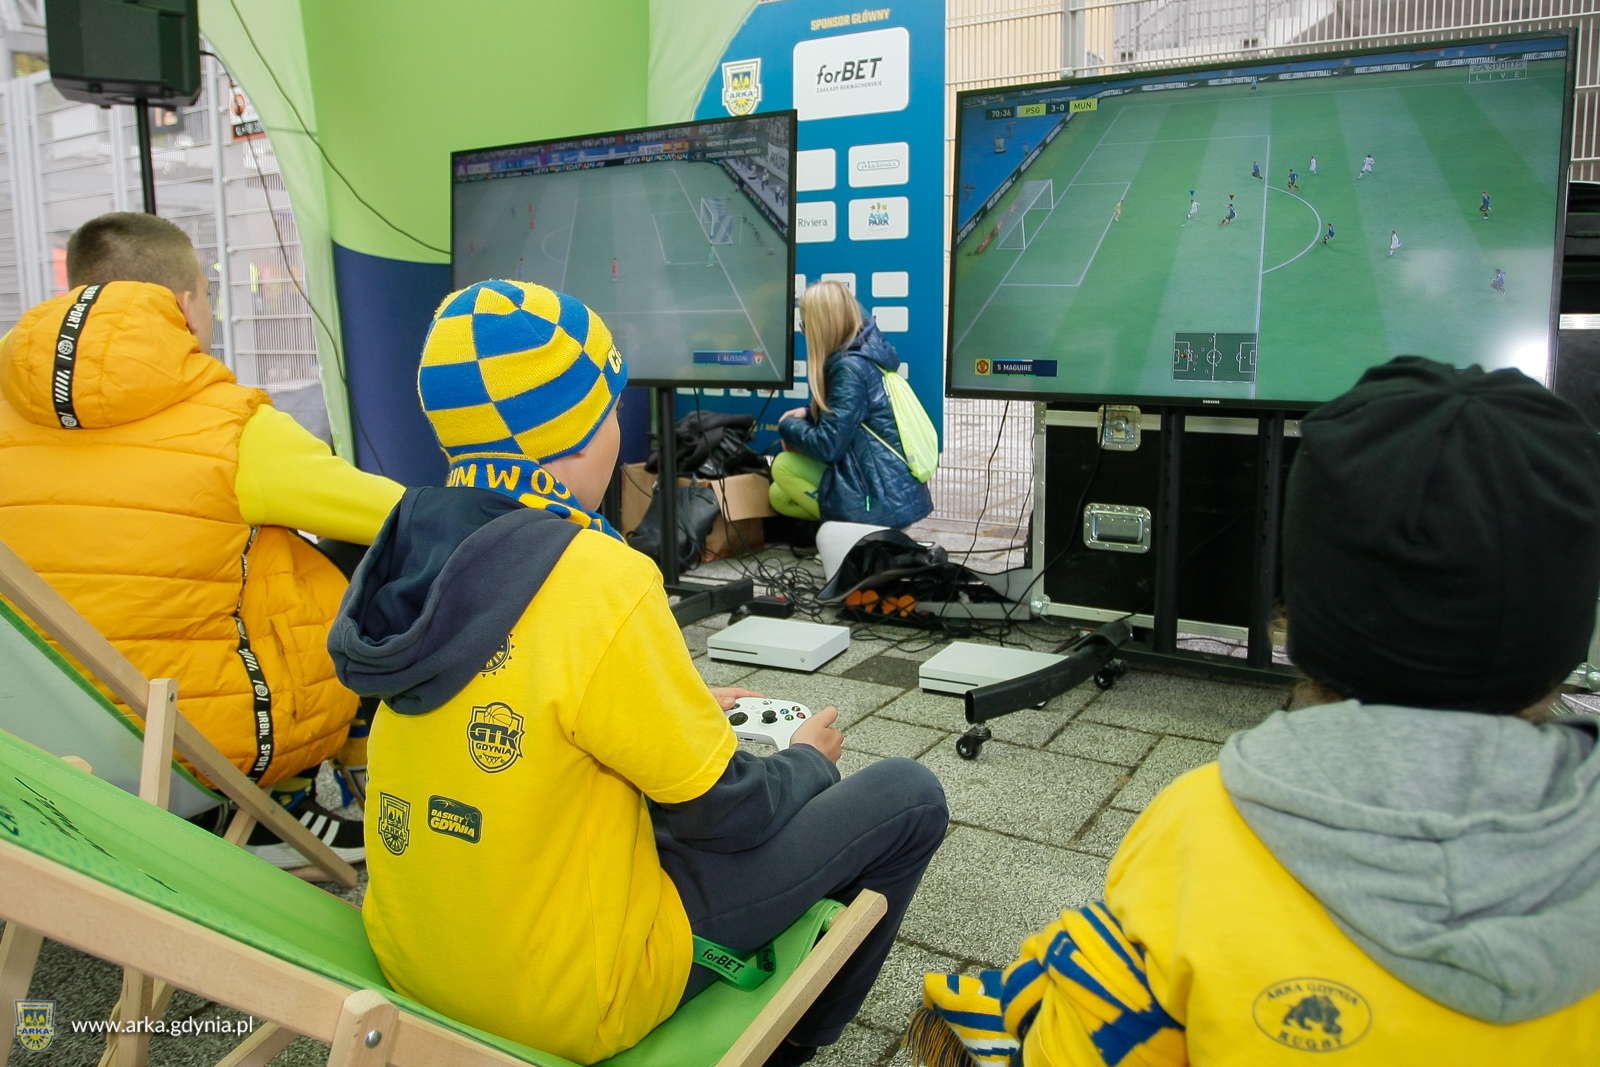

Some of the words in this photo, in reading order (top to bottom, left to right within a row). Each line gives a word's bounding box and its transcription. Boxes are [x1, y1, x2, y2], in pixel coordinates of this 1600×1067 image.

[811, 14, 850, 31] SPONSOR
[851, 8, 891, 25] GŁÓWNY
[817, 56, 883, 85] forBET
[1472, 64, 1487, 72] EA
[1489, 60, 1523, 71] SPORTS
[840, 80, 883, 91] BUKMACHERSKIE
[1475, 71, 1520, 81] LIVE
[729, 90, 754, 99] ARKA
[991, 109, 1011, 118] 70:36
[1025, 107, 1040, 115] PSG
[1051, 104, 1065, 112] 3-0
[1073, 101, 1092, 110] MUN
[624, 157, 641, 165] UEFA
[798, 217, 828, 228] Riviera
[66, 303, 88, 330] SPORT
[257, 710, 270, 739] URBN.
[469, 722, 520, 751] GTK
[254, 743, 271, 771] SPORT
[475, 742, 512, 756] GDYNIA
[431, 808, 465, 824] BASKET
[384, 825, 403, 839] ARKA
[430, 816, 475, 838] GDYNIA
[701, 948, 745, 974] forBET
[1267, 983, 1303, 1001] ARKA
[1306, 983, 1359, 1006] GDYNIA
[1278, 1029, 1342, 1051] RUGBY
